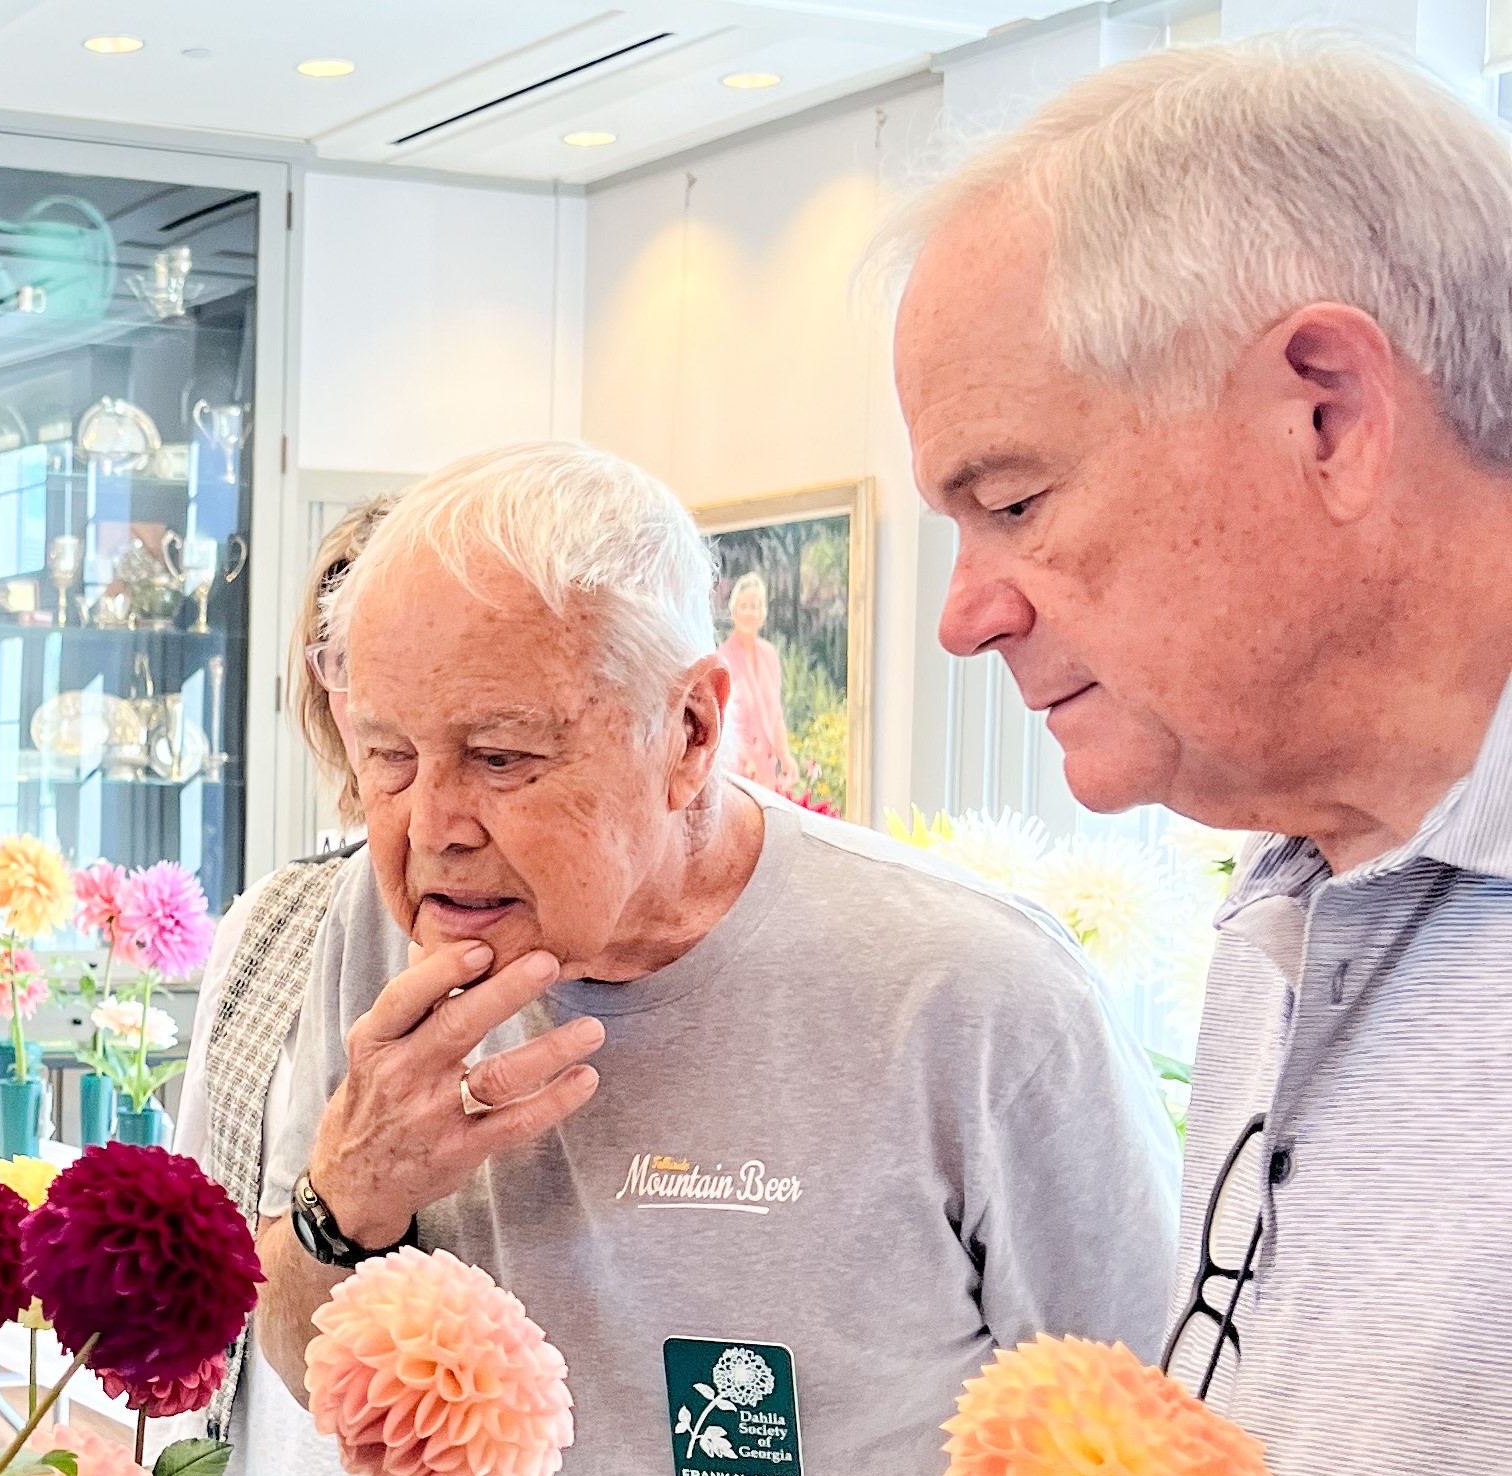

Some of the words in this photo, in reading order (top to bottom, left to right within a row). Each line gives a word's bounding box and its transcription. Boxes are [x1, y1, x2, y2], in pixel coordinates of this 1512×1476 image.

[615, 1153, 734, 1200] Mountain
[735, 1159, 804, 1202] Beer
[738, 1410, 786, 1426] Dahlia
[738, 1422, 788, 1440] Society
[757, 1436, 773, 1448] of
[738, 1446, 793, 1464] Georgia
